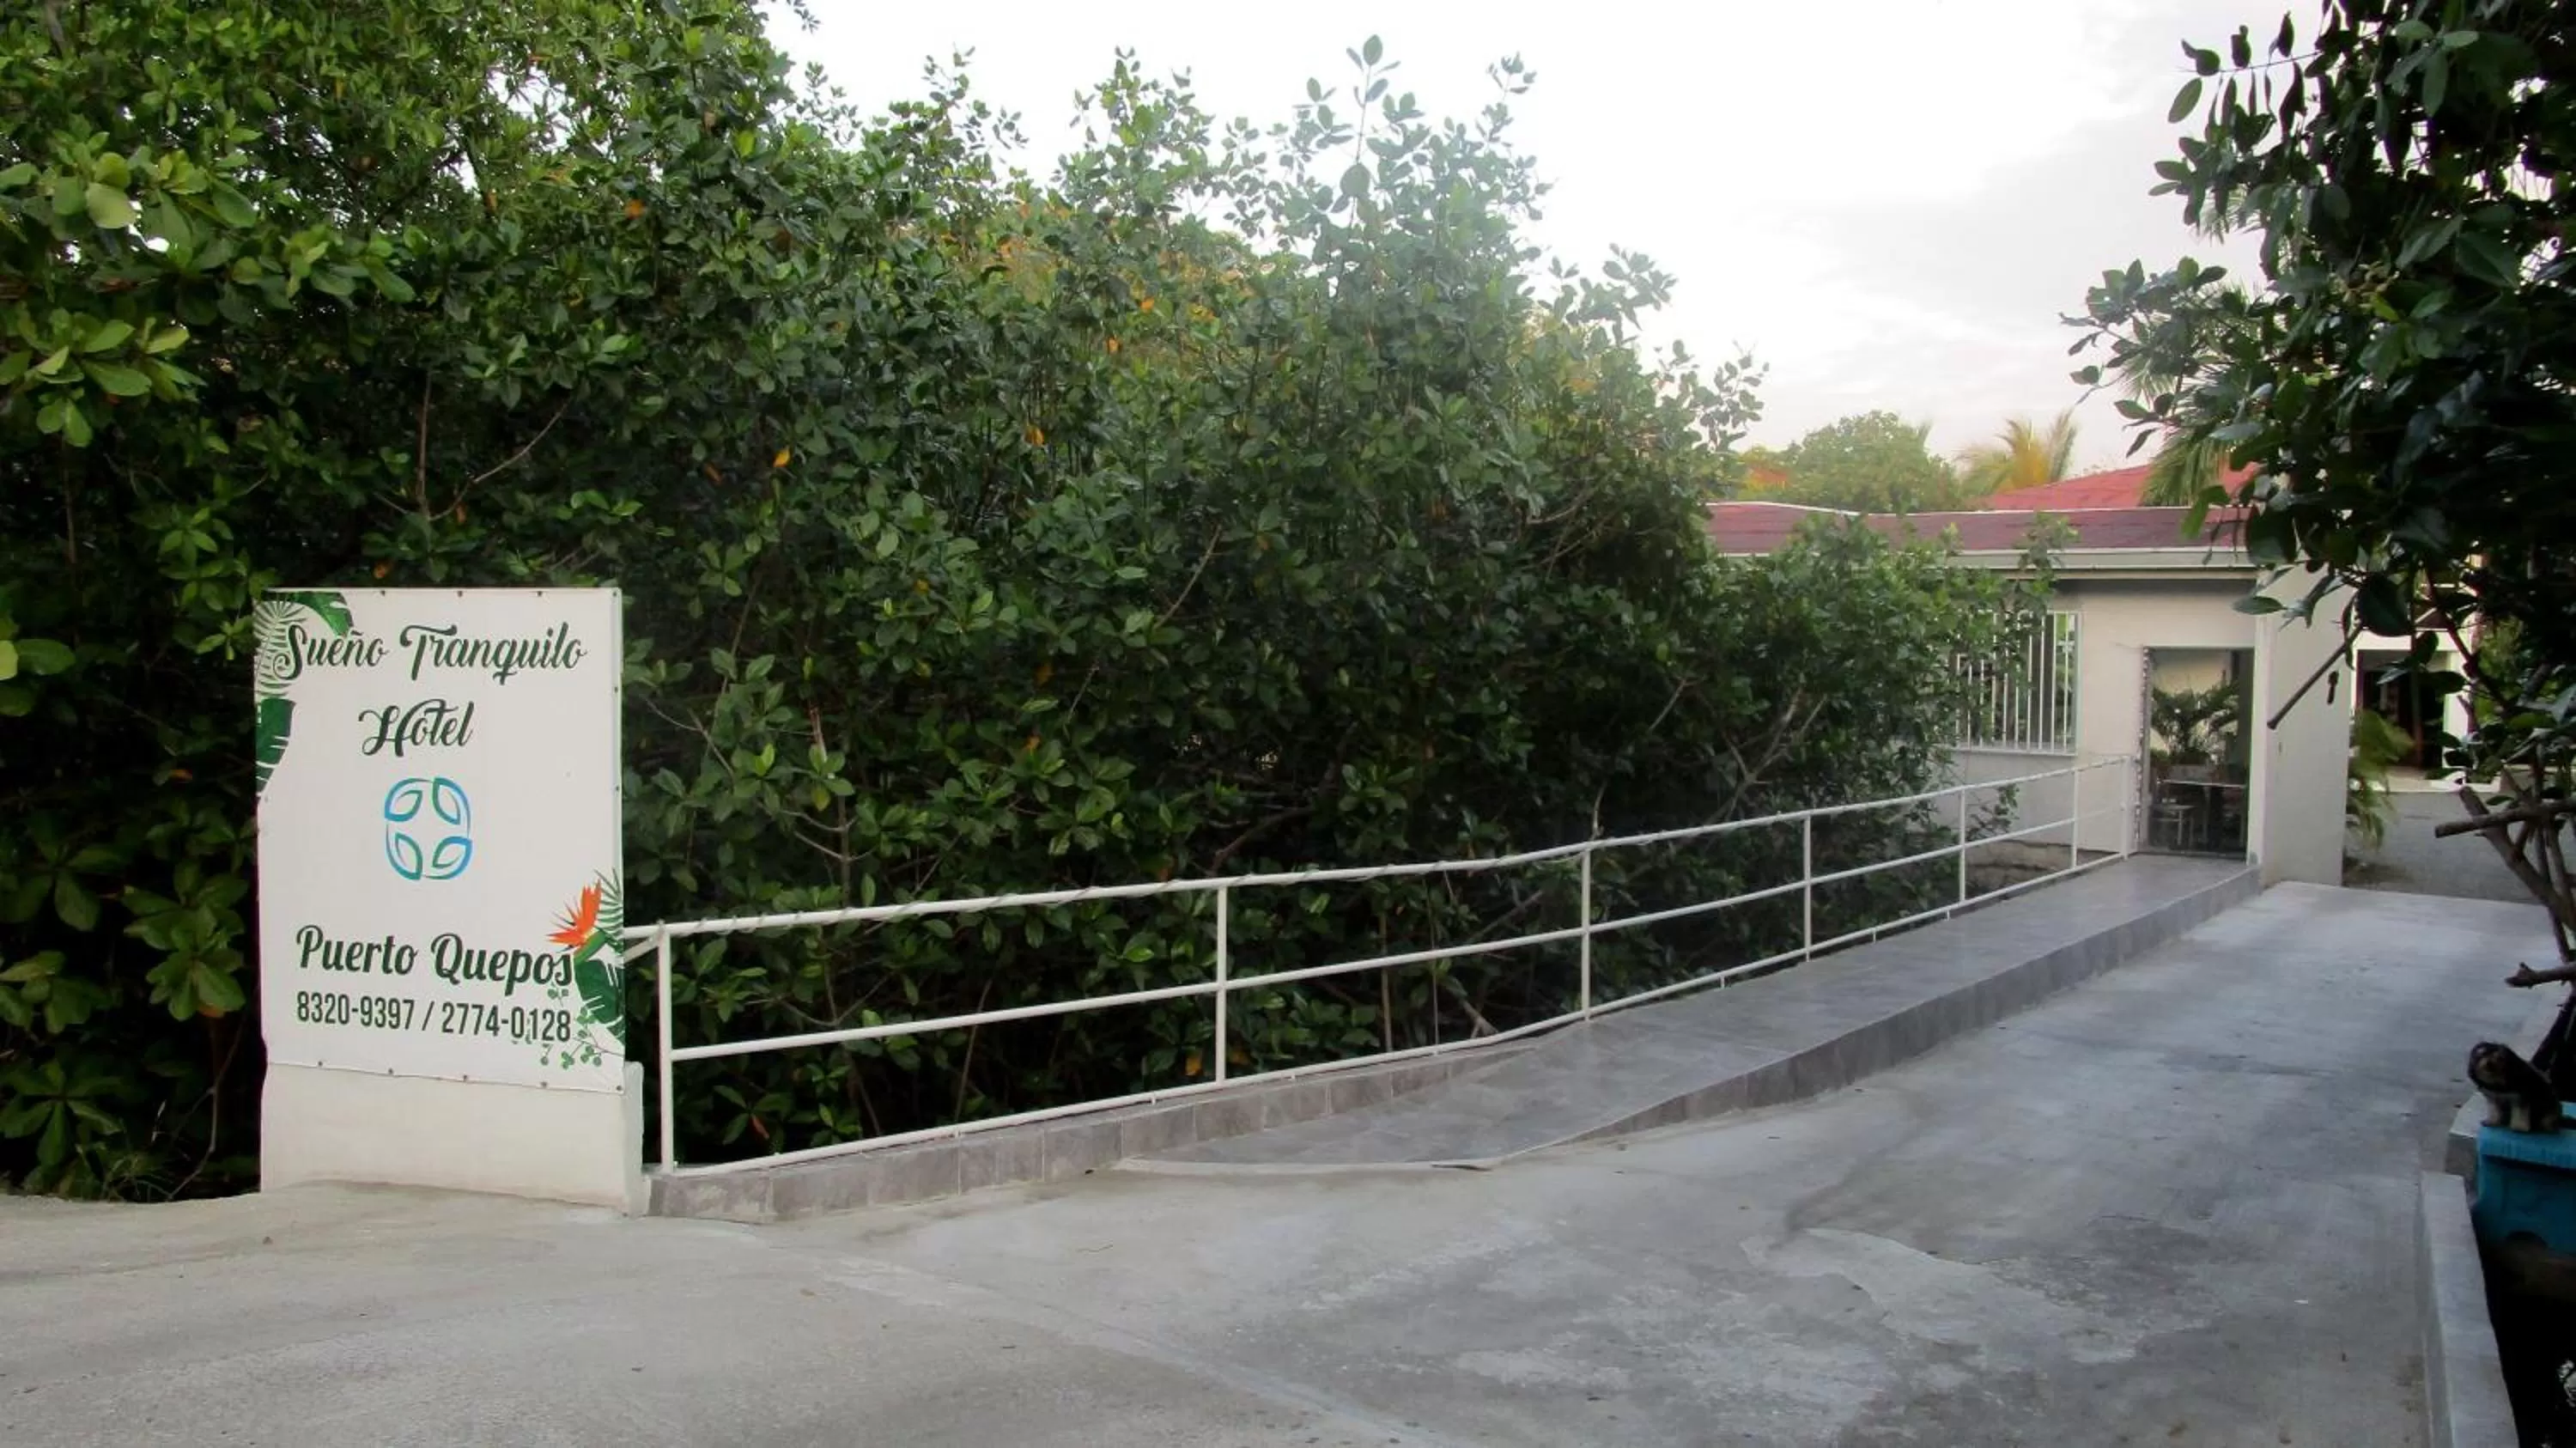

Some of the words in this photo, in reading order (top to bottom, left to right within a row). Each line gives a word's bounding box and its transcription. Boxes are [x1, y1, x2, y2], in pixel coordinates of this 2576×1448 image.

[273, 624, 388, 681] Sueño
[399, 622, 587, 685] Tranquilo
[358, 697, 475, 757] Hotel
[295, 924, 417, 976] Puerto
[430, 932, 573, 997] Quepos
[296, 990, 415, 1031] 8320-9397
[422, 1001, 434, 1031] /
[440, 1001, 572, 1043] 2774-0128
